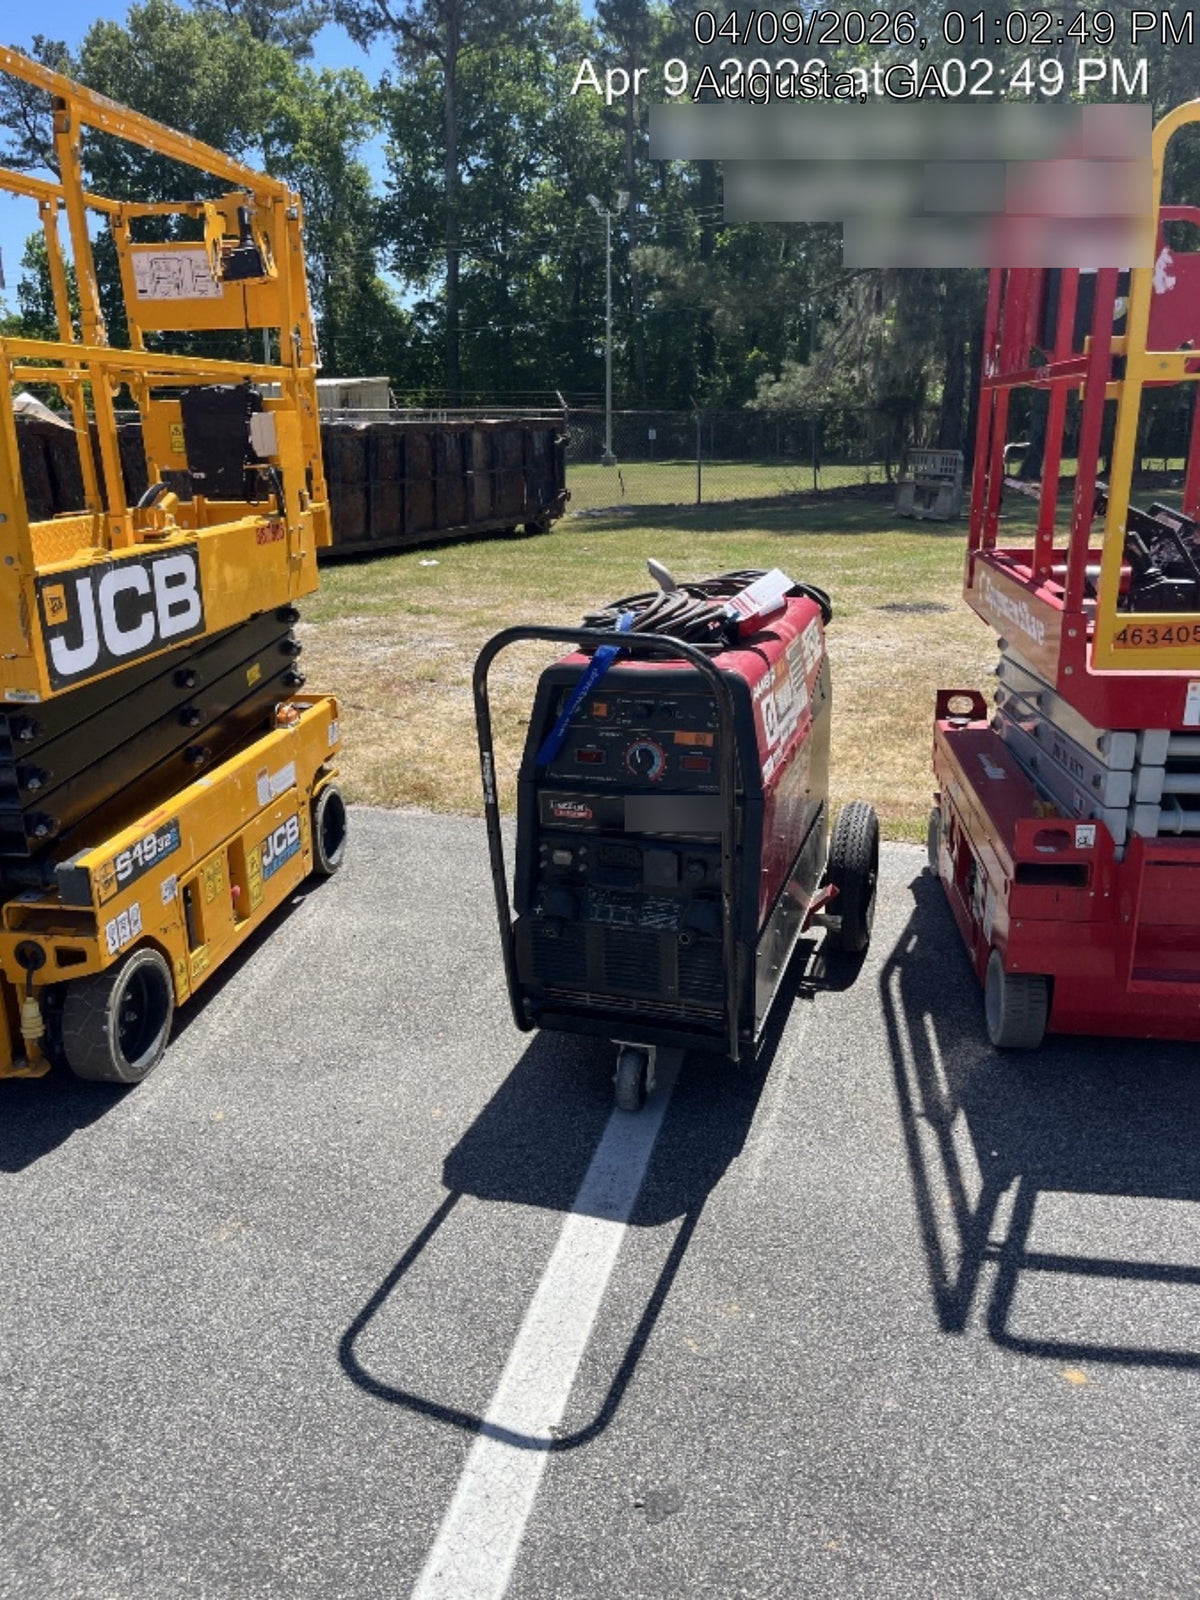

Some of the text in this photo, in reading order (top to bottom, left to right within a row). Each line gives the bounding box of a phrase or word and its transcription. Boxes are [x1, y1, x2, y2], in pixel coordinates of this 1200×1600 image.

[50, 553, 202, 676] JCB
[1115, 624, 1200, 645] 463405
[262, 815, 300, 867] JCB
